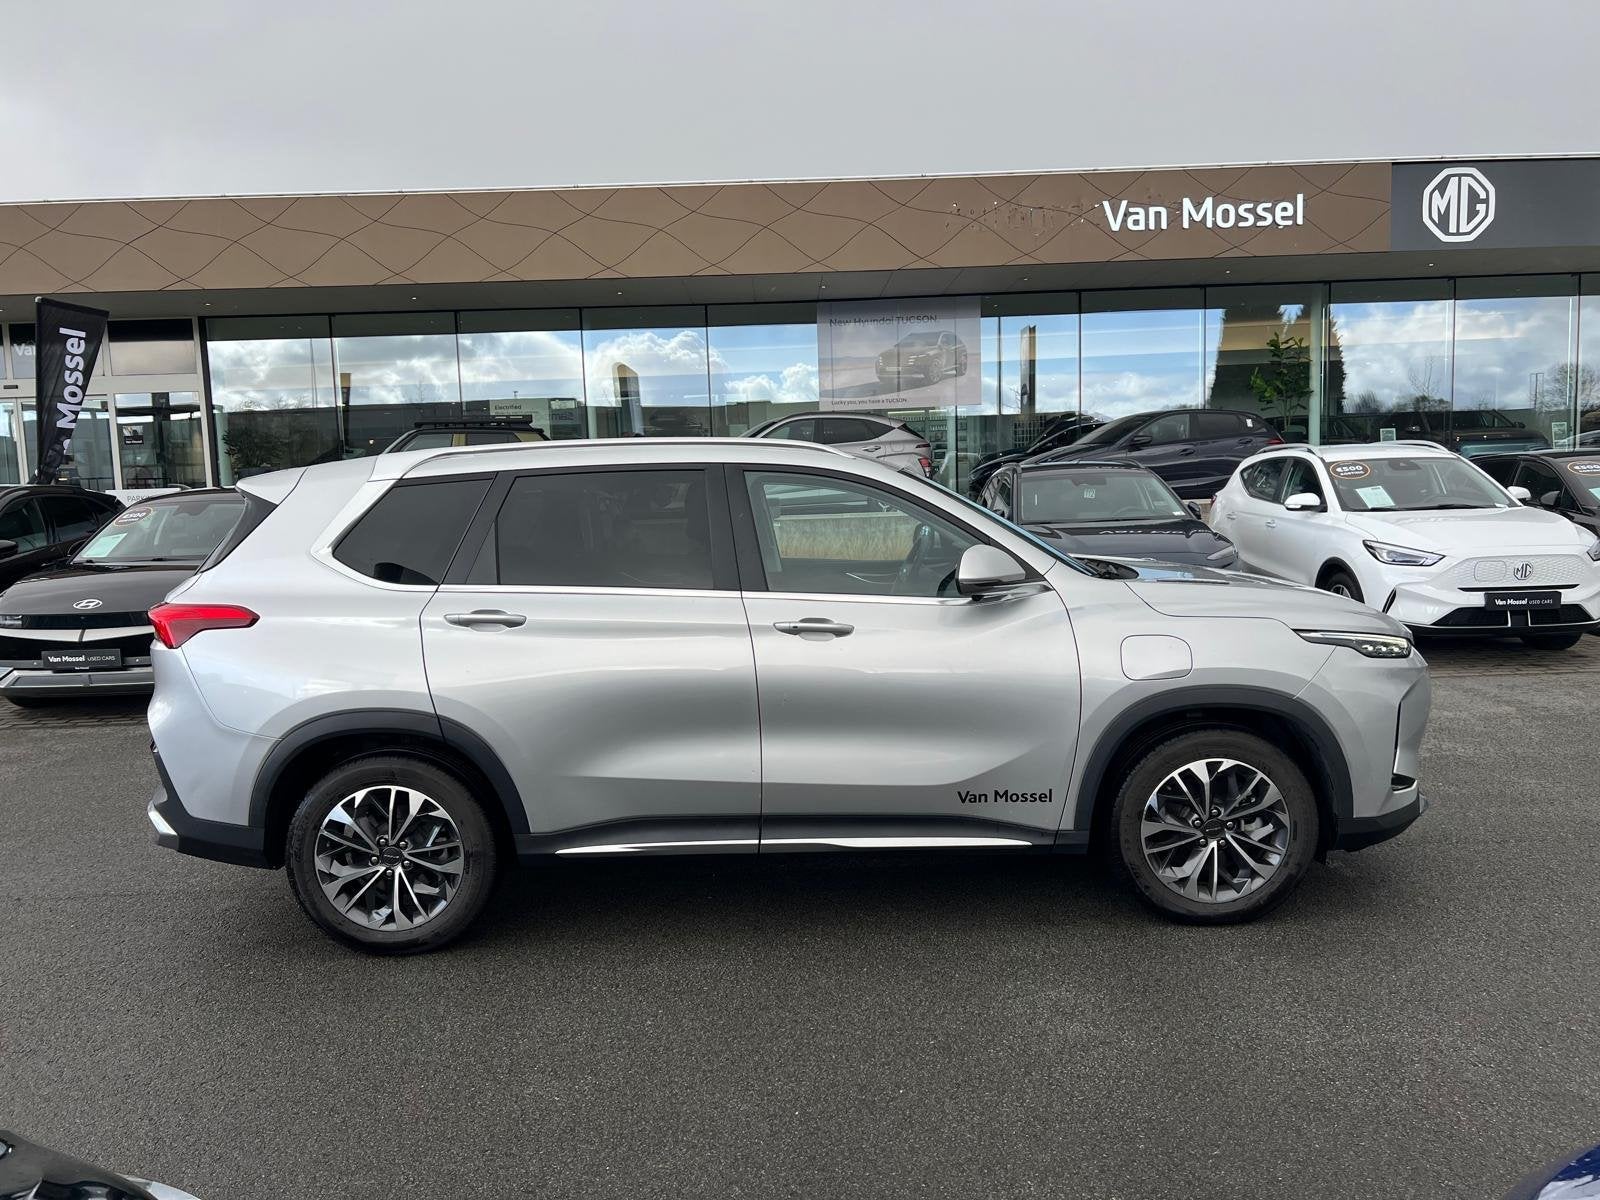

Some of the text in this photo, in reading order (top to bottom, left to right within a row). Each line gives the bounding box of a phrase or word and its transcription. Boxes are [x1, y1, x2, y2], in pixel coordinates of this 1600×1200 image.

[1102, 193, 1305, 232] Van Mossel
[1429, 174, 1489, 236] MG
[829, 318, 852, 328] New
[854, 316, 894, 327] Hyundai
[56, 327, 87, 429] Mossel
[1494, 598, 1506, 606] Van
[1507, 597, 1528, 606] Mossel
[957, 788, 1053, 804] Van Mossel
